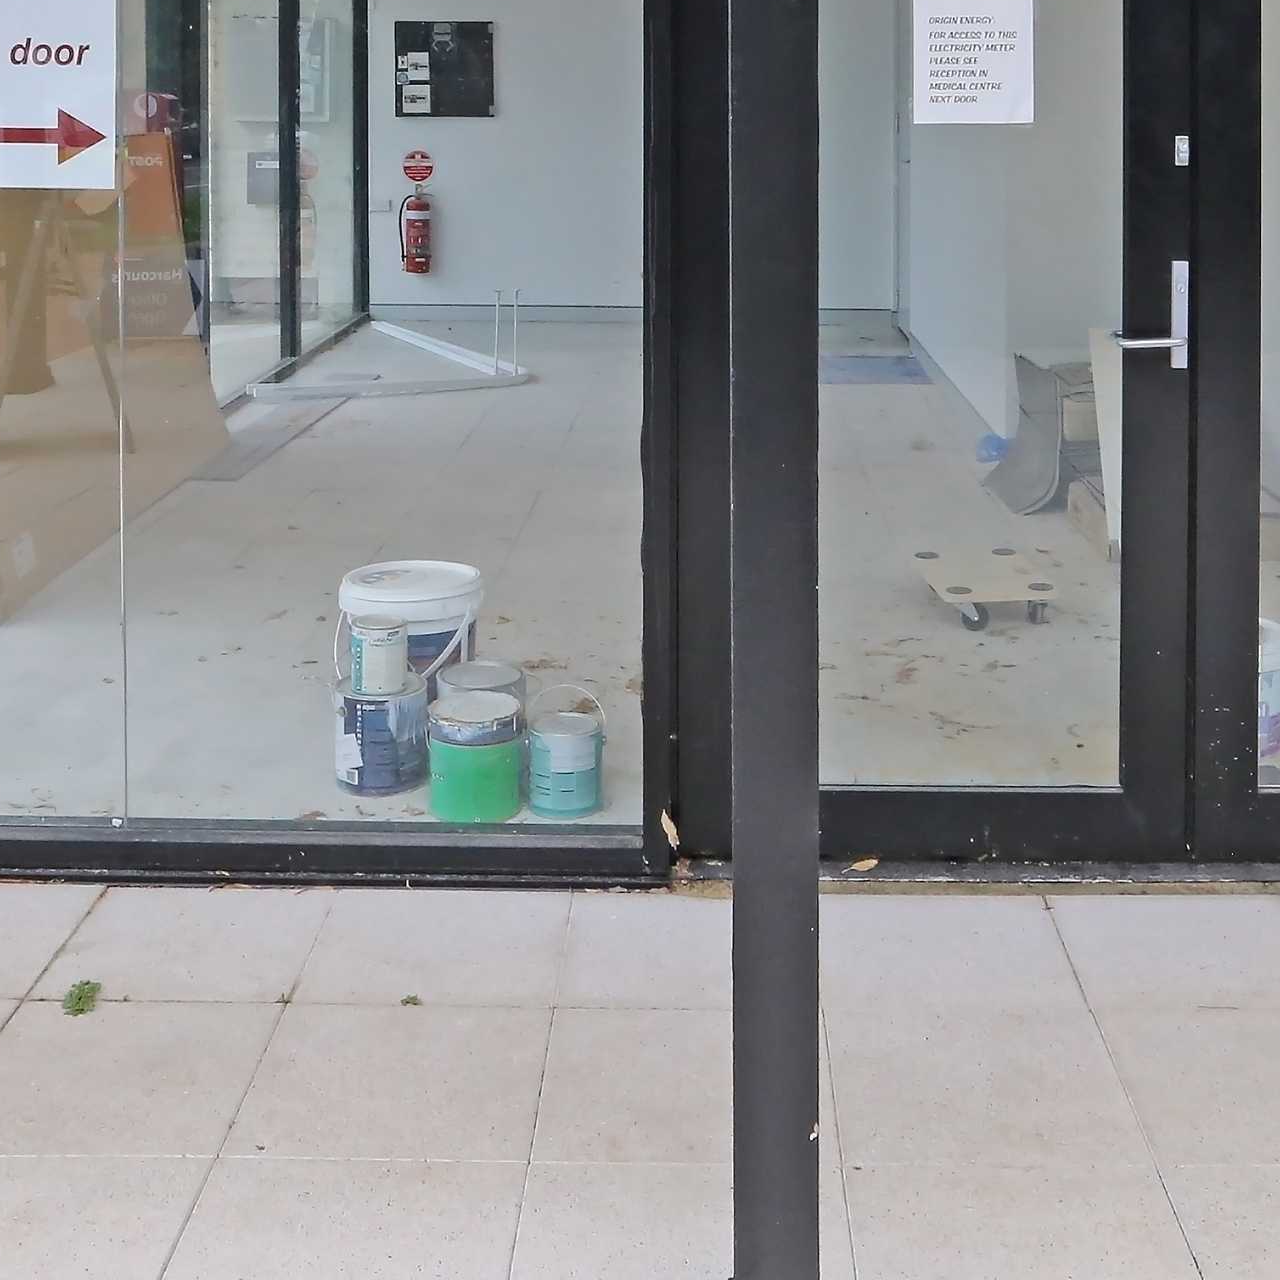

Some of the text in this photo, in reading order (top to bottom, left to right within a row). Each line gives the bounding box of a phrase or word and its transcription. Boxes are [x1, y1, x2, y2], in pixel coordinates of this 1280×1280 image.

[928, 16, 958, 24] ORIGIN
[928, 31, 1017, 39] FOR ACCESS TO THIS
[9, 37, 90, 66] door
[928, 44, 1016, 52] ELECTRICITY METER
[928, 57, 978, 65] PLEASE SEE
[928, 70, 989, 78] RECEPTION IN
[928, 83, 1003, 91] MEDICAL CENTRE
[928, 96, 978, 104] NEXT DOOR
